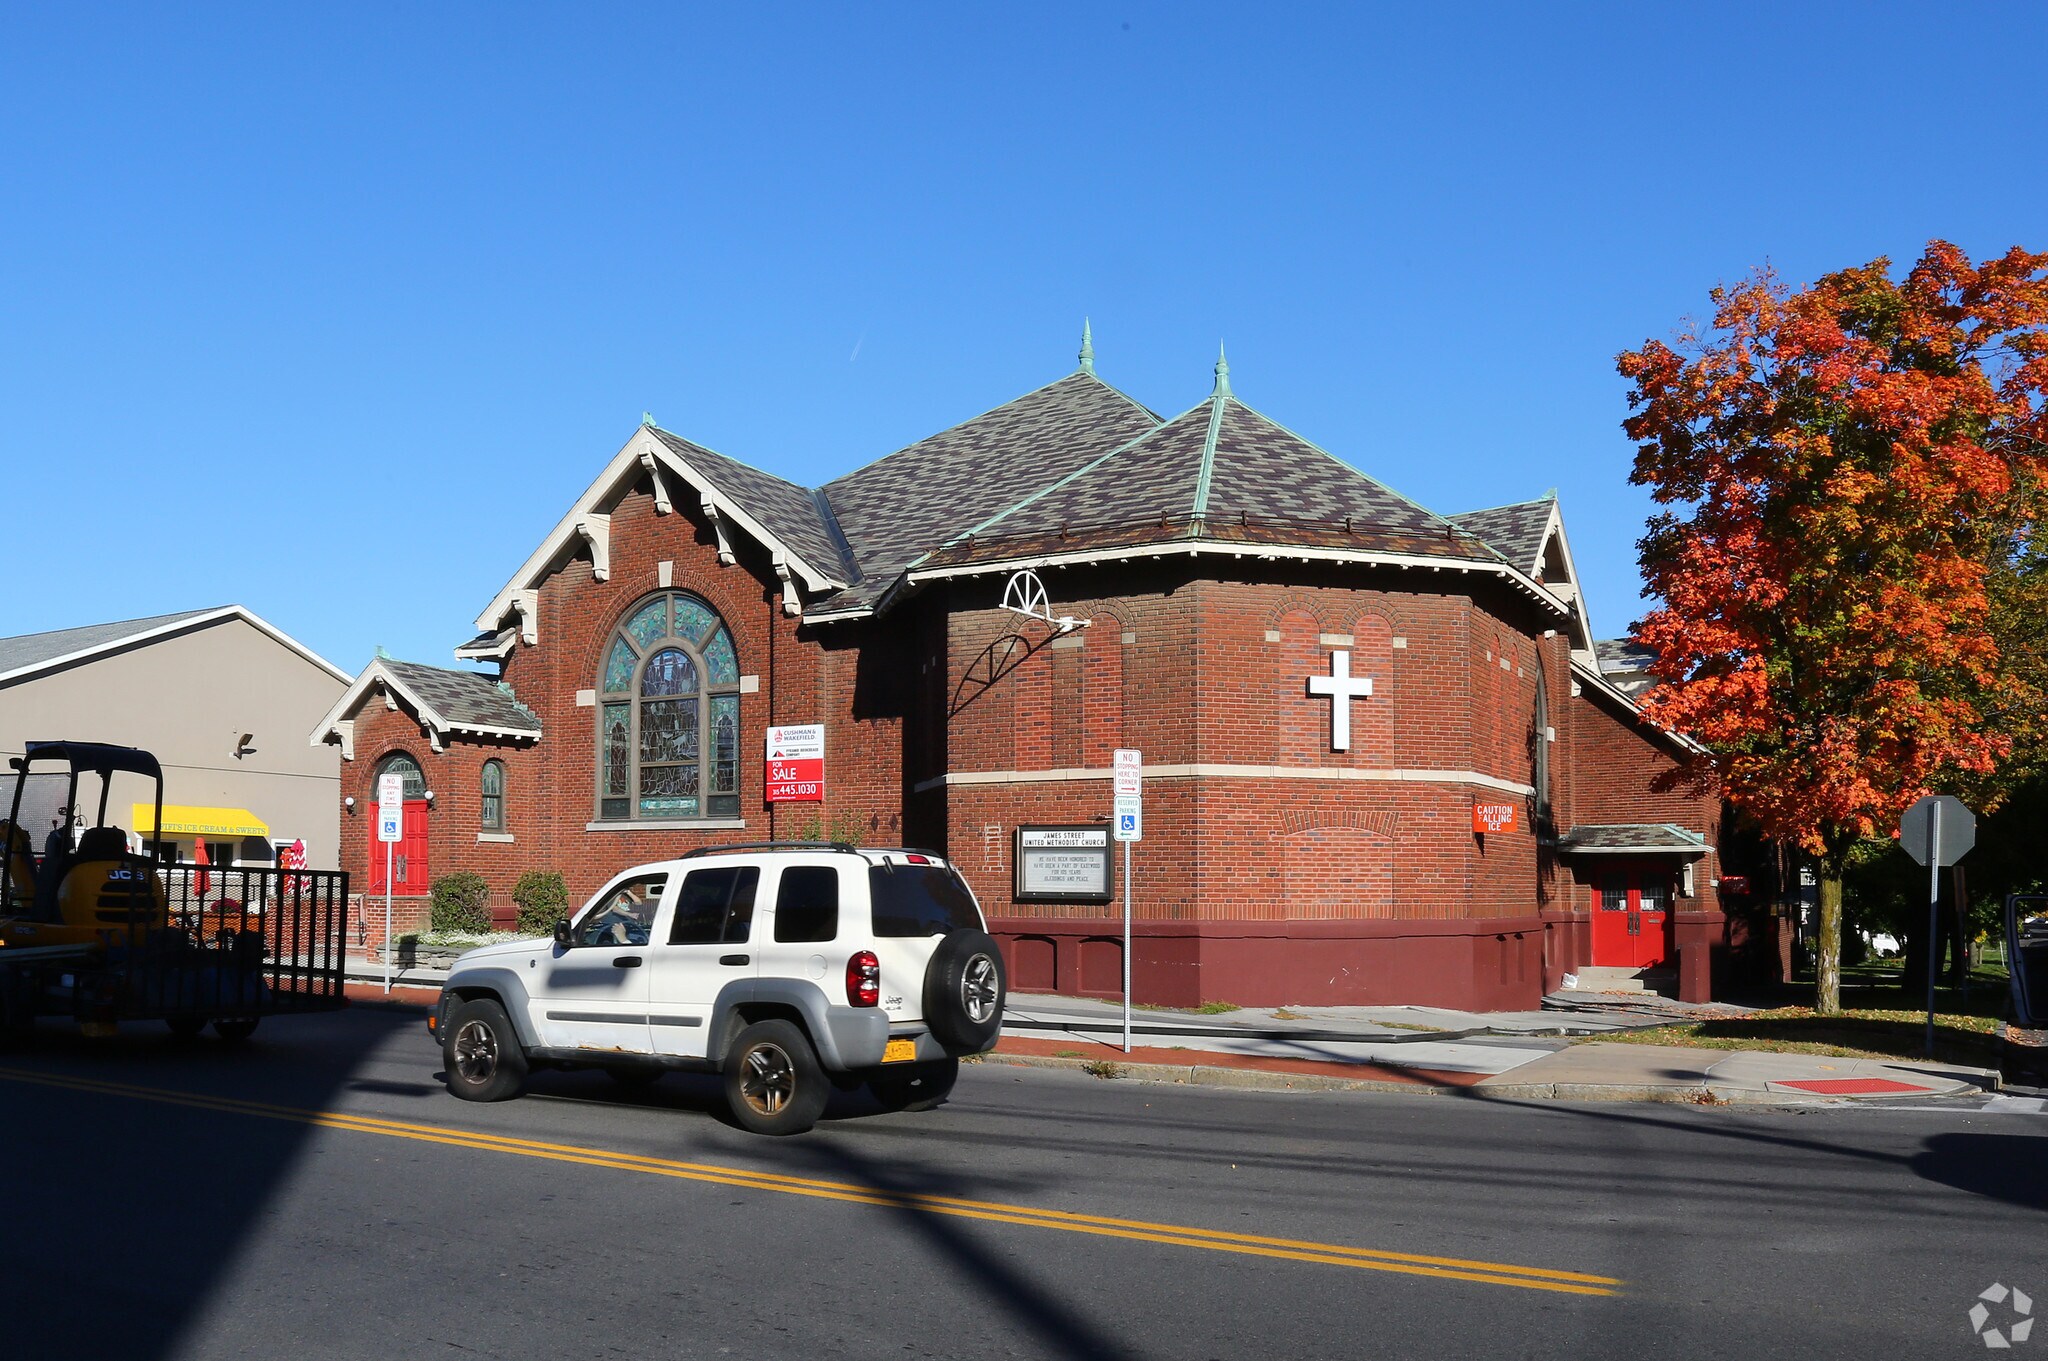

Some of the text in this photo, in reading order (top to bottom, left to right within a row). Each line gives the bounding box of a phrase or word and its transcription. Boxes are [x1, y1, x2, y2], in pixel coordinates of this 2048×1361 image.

[1122, 753, 1134, 762] NO
[772, 768, 796, 780] SALE
[780, 784, 816, 795] 445.1030
[1477, 806, 1512, 815] CAUTION
[1478, 814, 1512, 823] FALLING
[184, 824, 198, 832] ICE
[199, 824, 227, 833] CREAM
[236, 826, 266, 834] SWEETS
[1488, 822, 1502, 831] ICE
[885, 995, 903, 1005] Jeep
